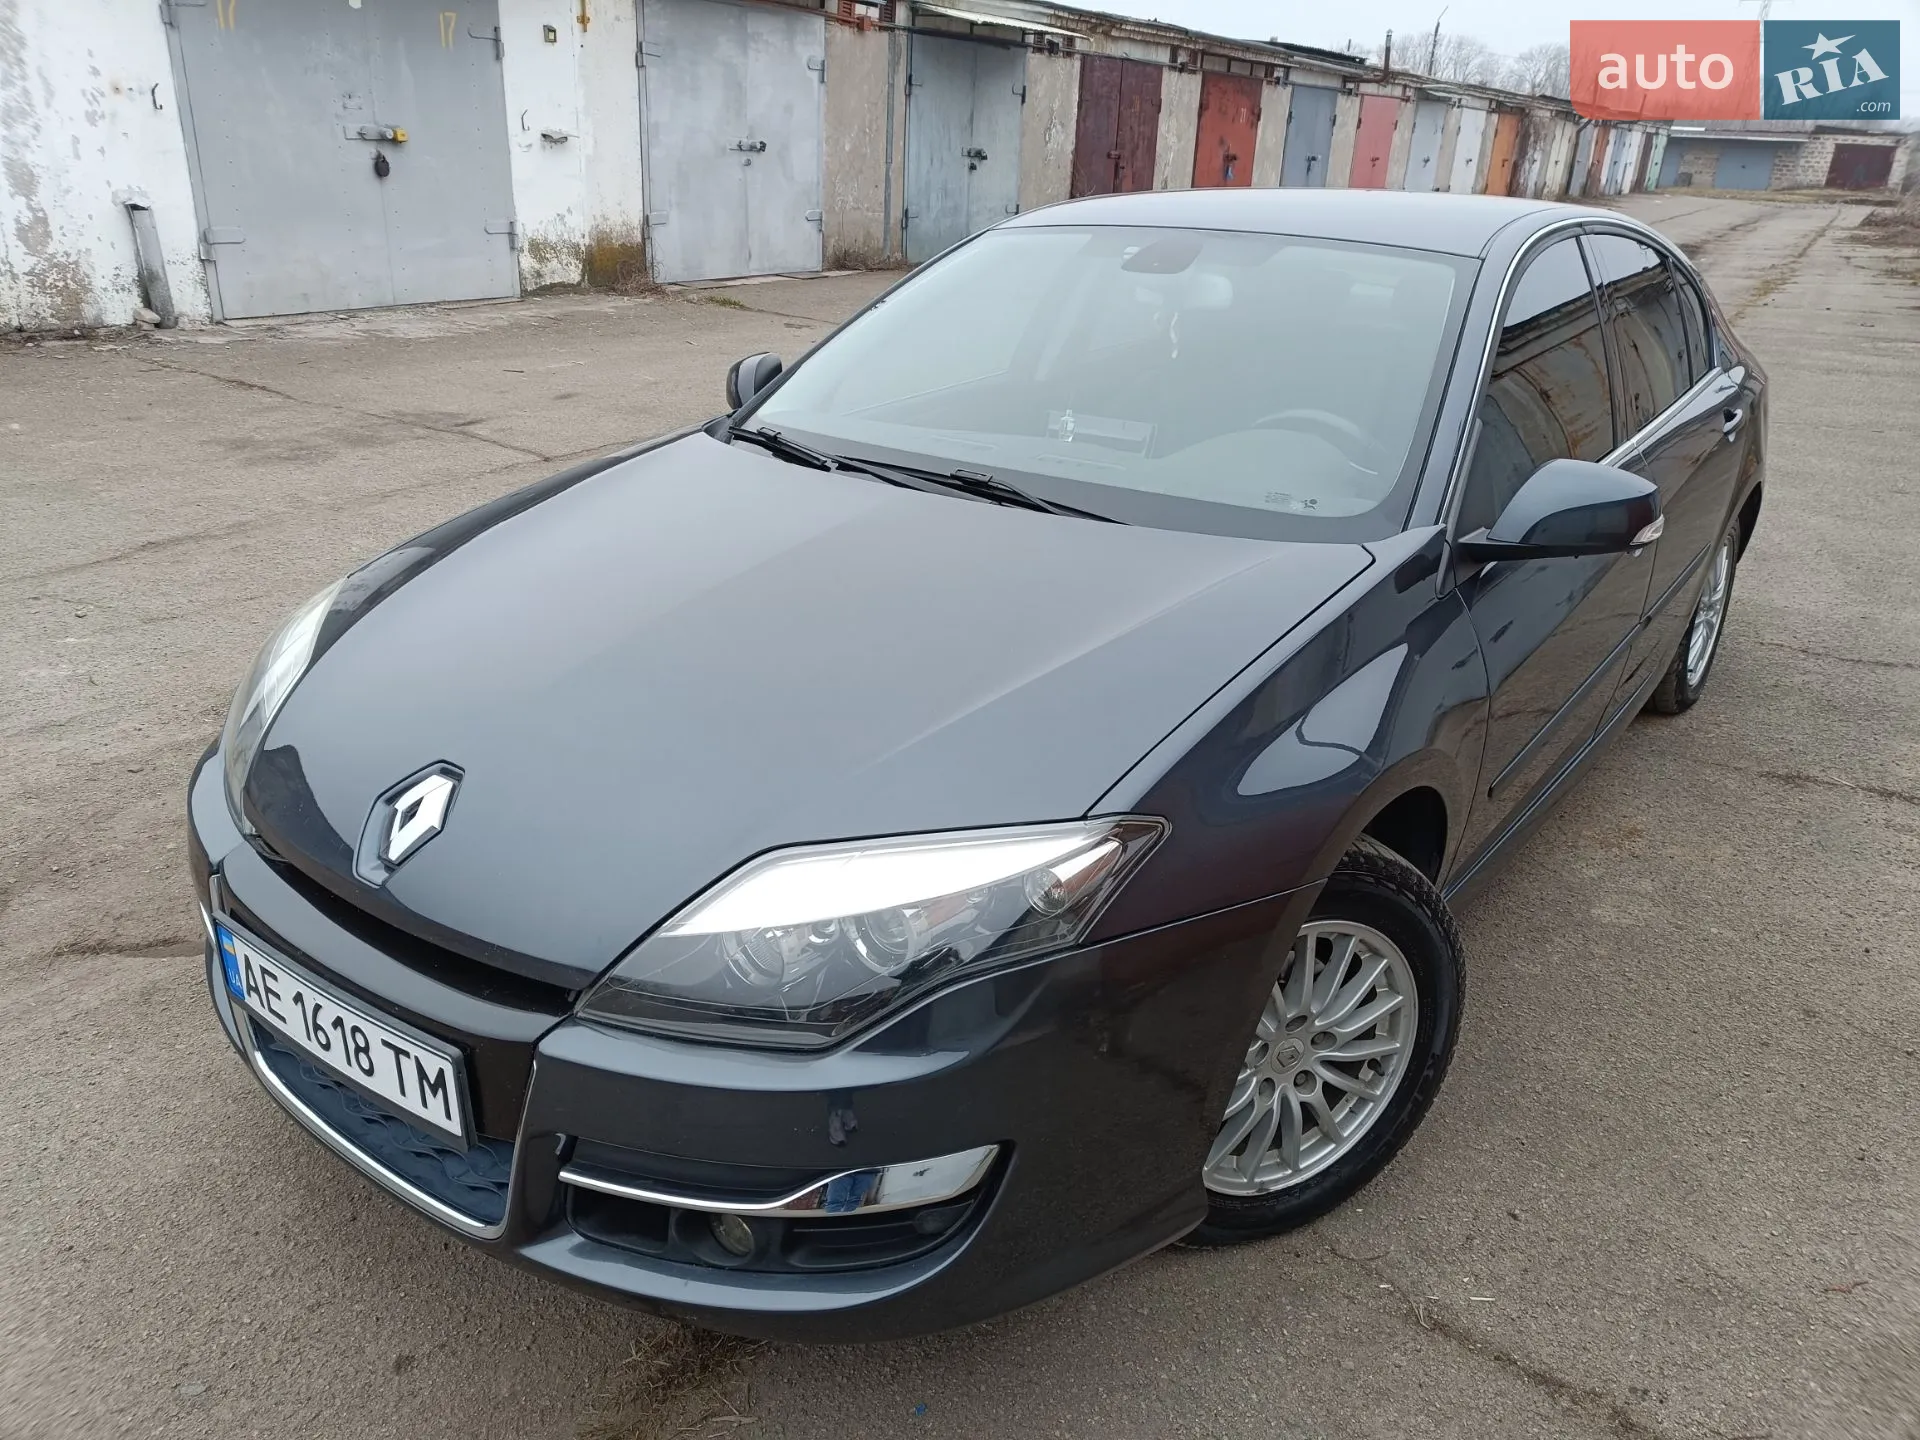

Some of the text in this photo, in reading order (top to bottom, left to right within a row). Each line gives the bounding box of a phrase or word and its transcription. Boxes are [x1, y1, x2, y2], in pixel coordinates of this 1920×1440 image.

[440, 12, 456, 48] 17
[228, 968, 243, 990] UA
[244, 953, 452, 1121] AE 1618 TM
